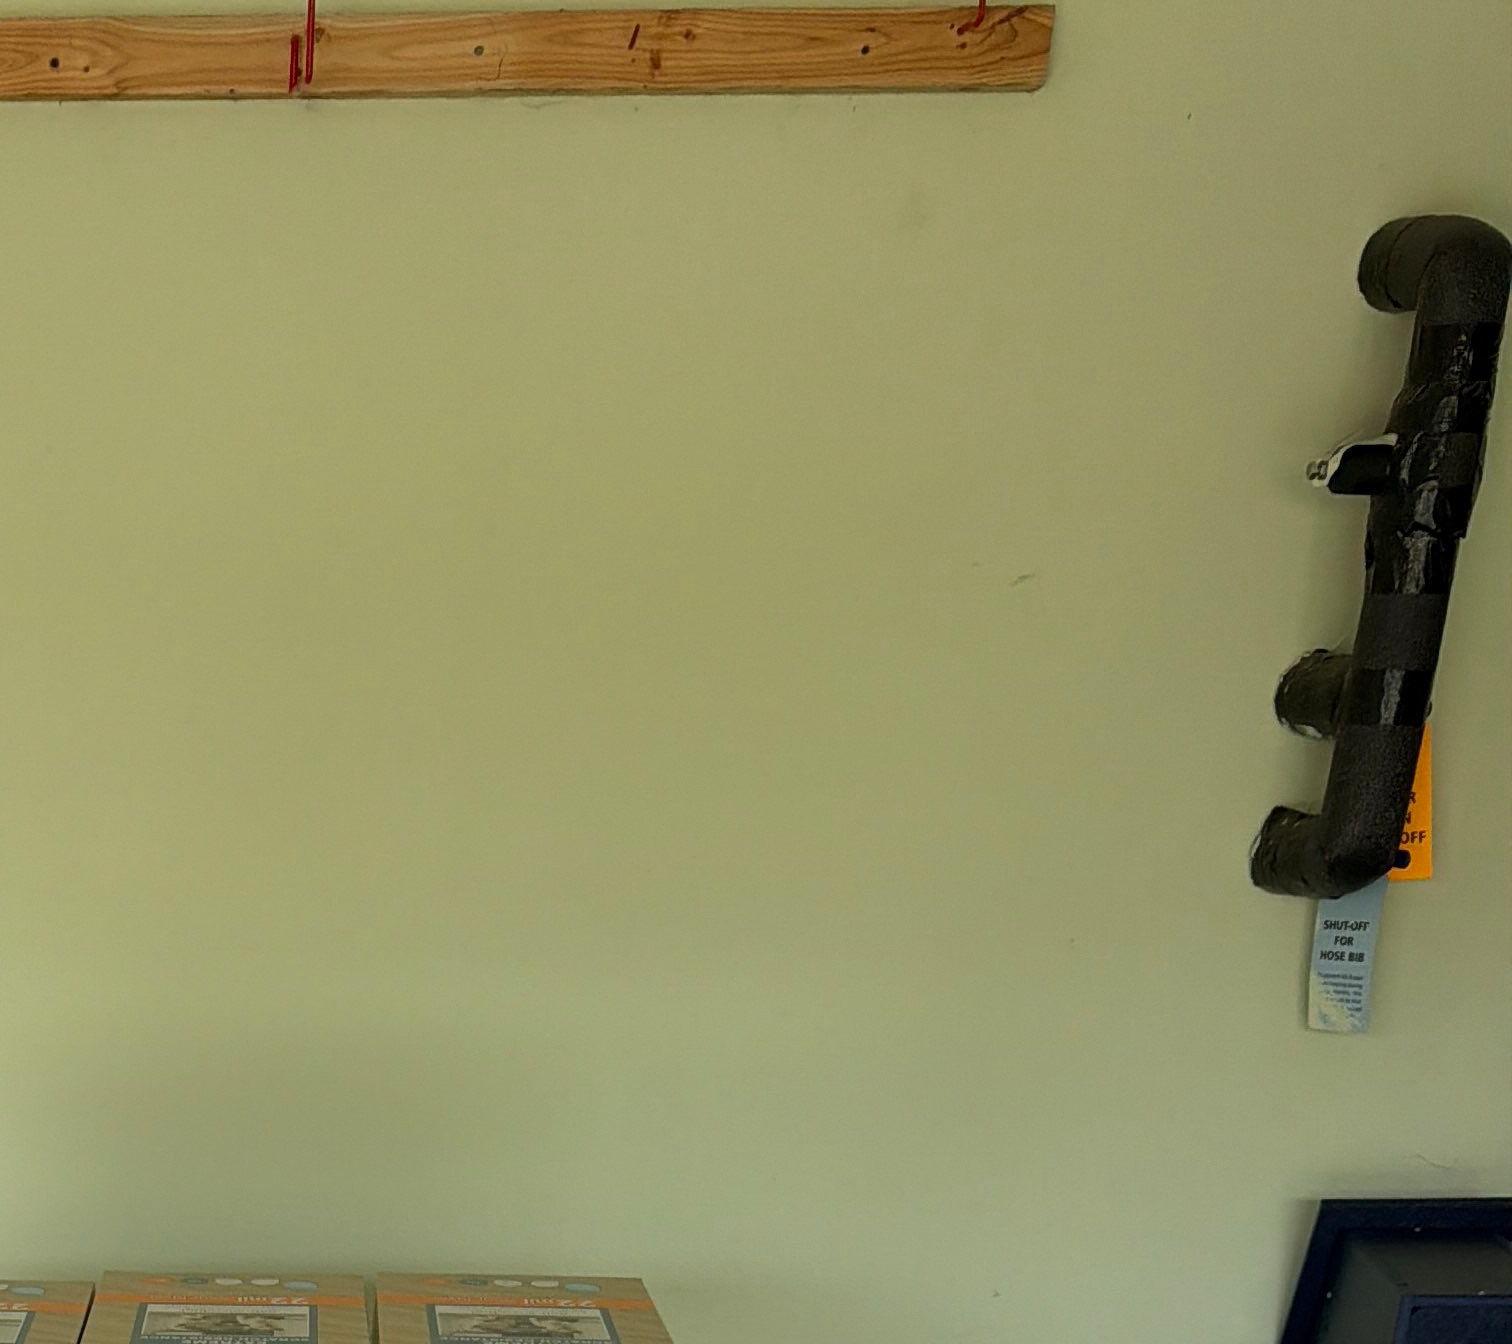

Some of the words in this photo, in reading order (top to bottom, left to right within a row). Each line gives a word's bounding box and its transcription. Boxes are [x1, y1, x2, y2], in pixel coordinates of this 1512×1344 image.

[1323, 919, 1370, 932] SHUT-OFF
[1334, 936, 1354, 947] FOR
[1320, 951, 1346, 962] HOSE
[1348, 952, 1365, 963] BIB
